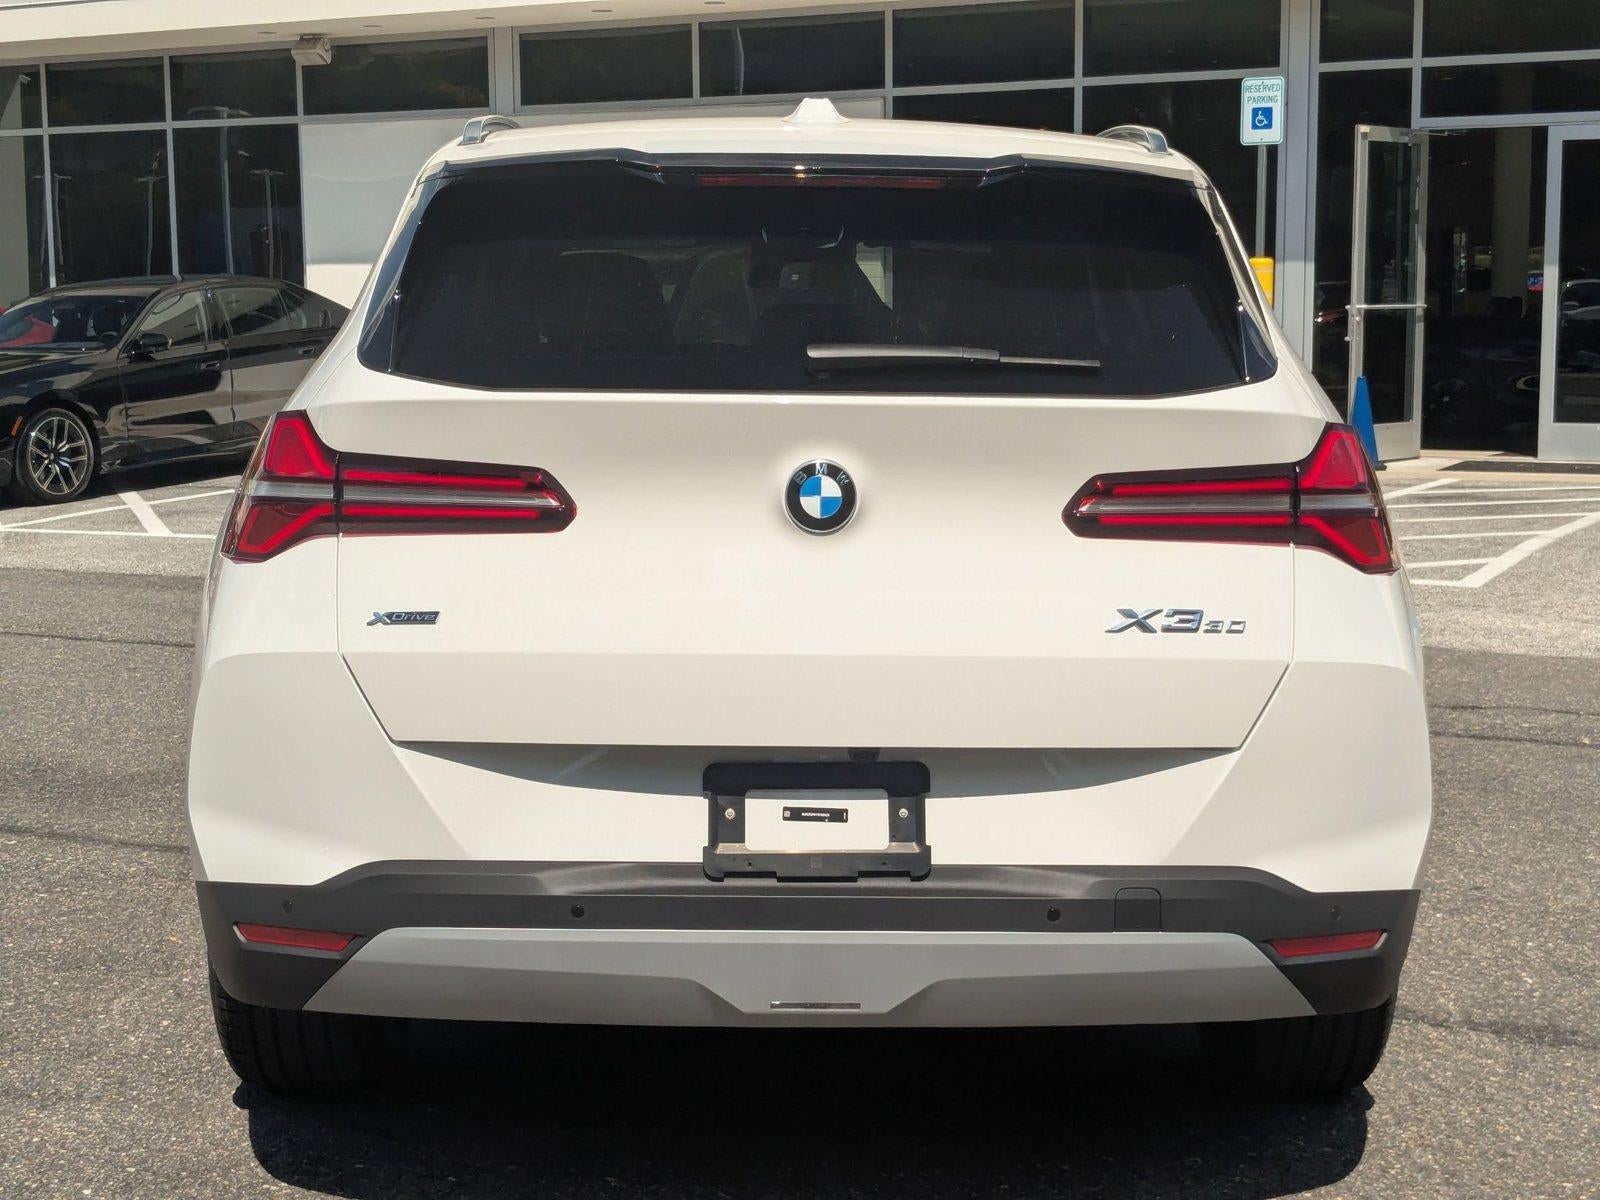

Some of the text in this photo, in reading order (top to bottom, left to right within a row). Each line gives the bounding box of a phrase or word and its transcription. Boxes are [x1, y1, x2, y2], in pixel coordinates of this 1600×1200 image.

[1244, 84, 1281, 93] RESERVED
[1247, 95, 1278, 104] PARKING
[793, 462, 850, 486] BMW
